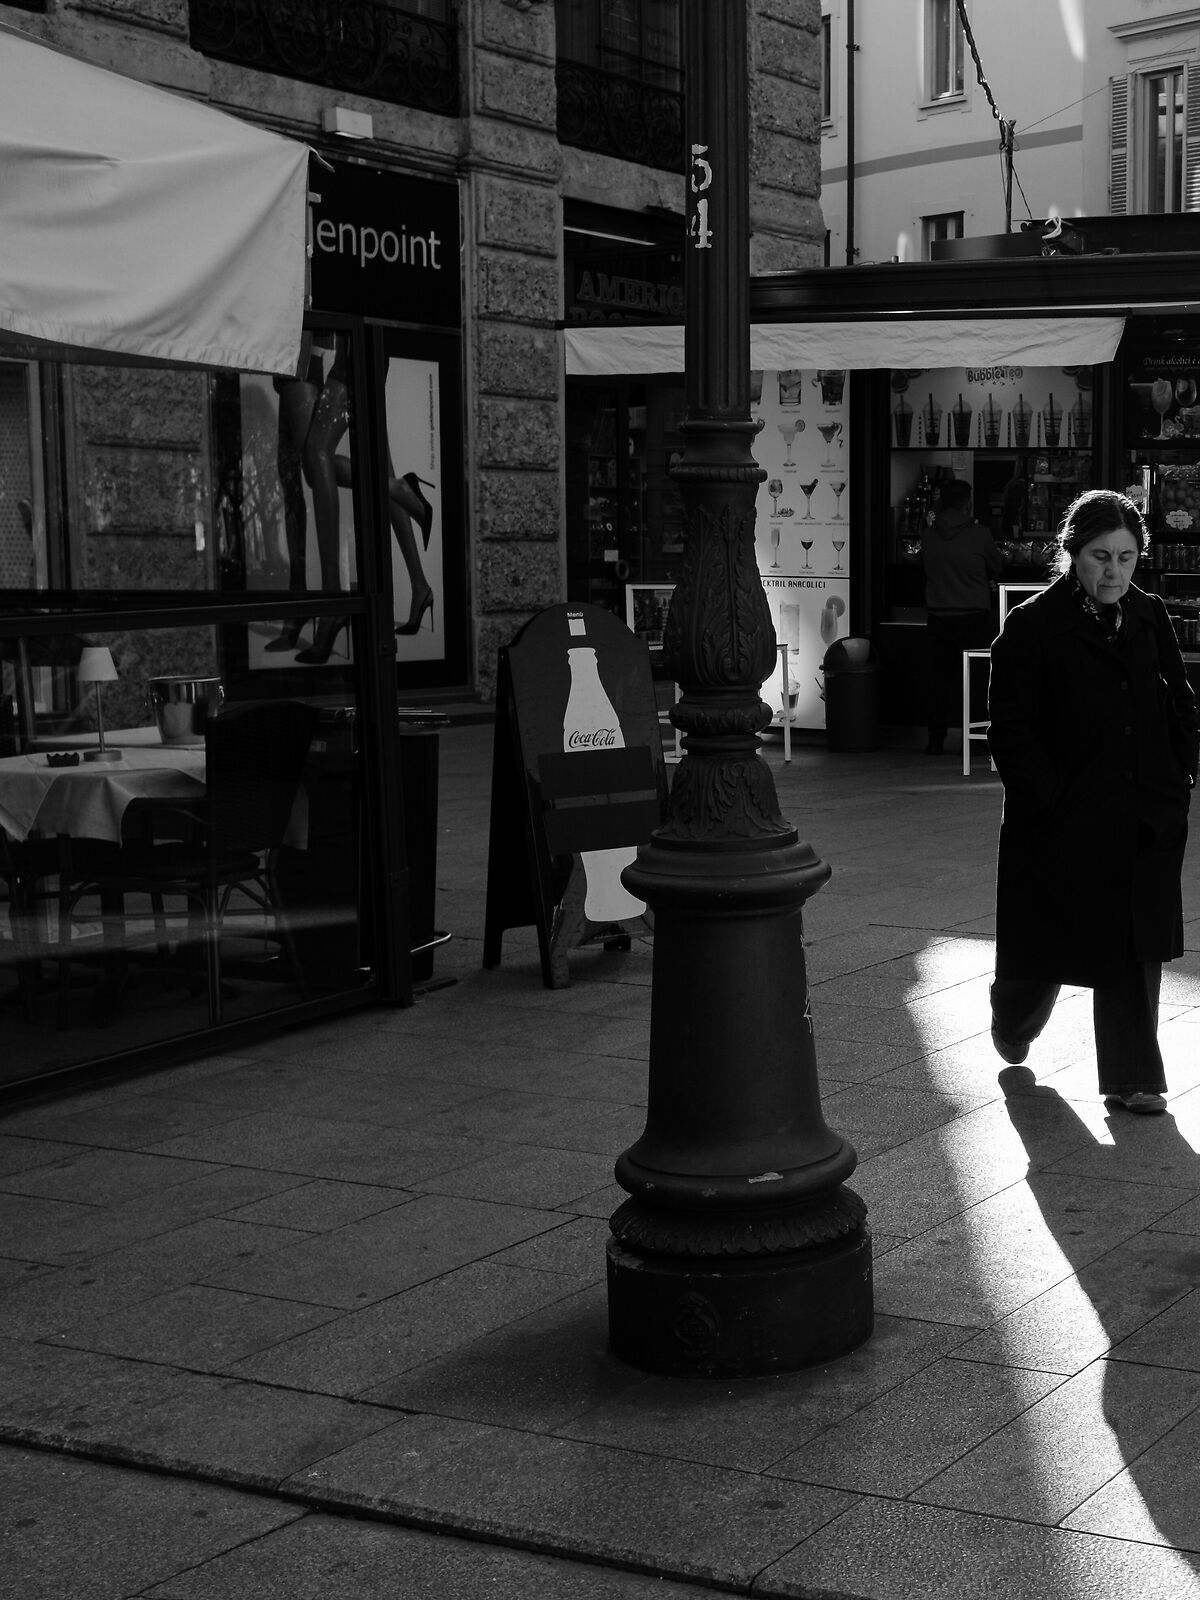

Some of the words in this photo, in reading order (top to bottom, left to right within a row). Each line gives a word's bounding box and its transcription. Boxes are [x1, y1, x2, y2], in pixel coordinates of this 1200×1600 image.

[312, 212, 441, 270] enpoint
[576, 270, 686, 316] AMERIC
[967, 367, 1001, 383] Bubble
[762, 580, 786, 588] CKTAIL
[568, 728, 617, 748] Coca-Cola
